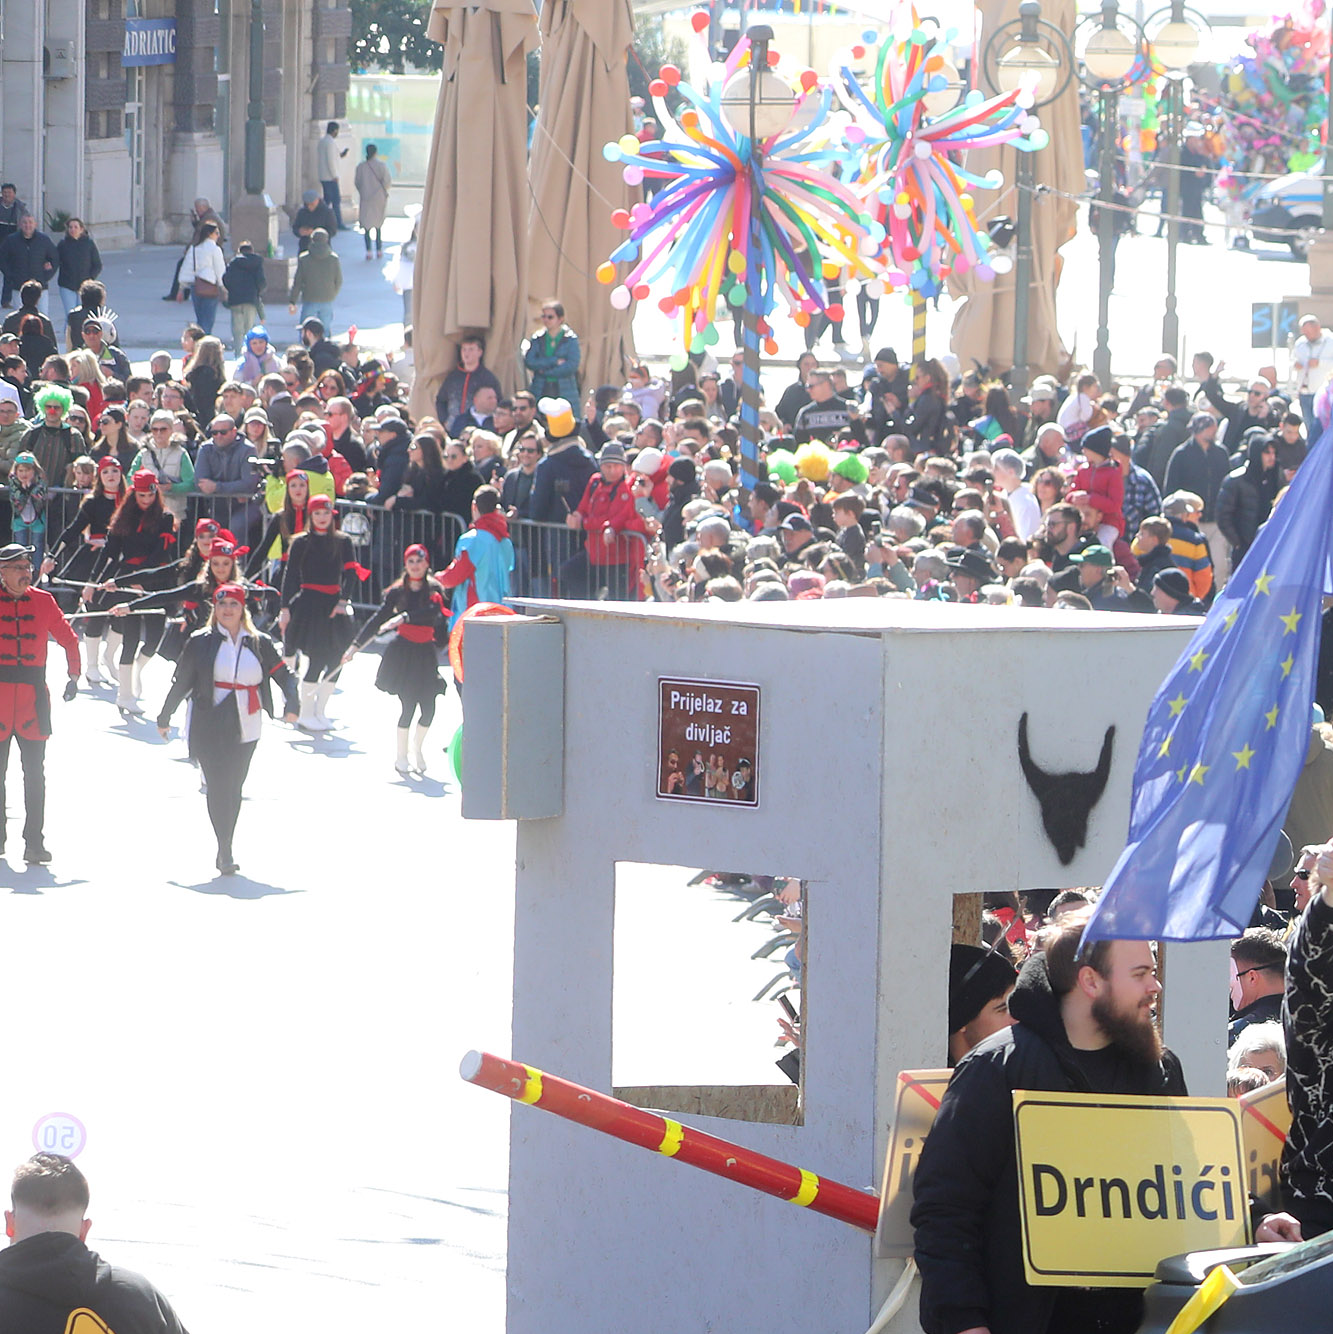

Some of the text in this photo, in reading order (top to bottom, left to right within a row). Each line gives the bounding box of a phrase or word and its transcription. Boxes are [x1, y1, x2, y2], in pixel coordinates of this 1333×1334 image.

[123, 28, 177, 57] ADRIATIC
[670, 690, 749, 716] Prijelaz za
[685, 721, 732, 748] divljač
[1030, 1162, 1237, 1222] Drndići
